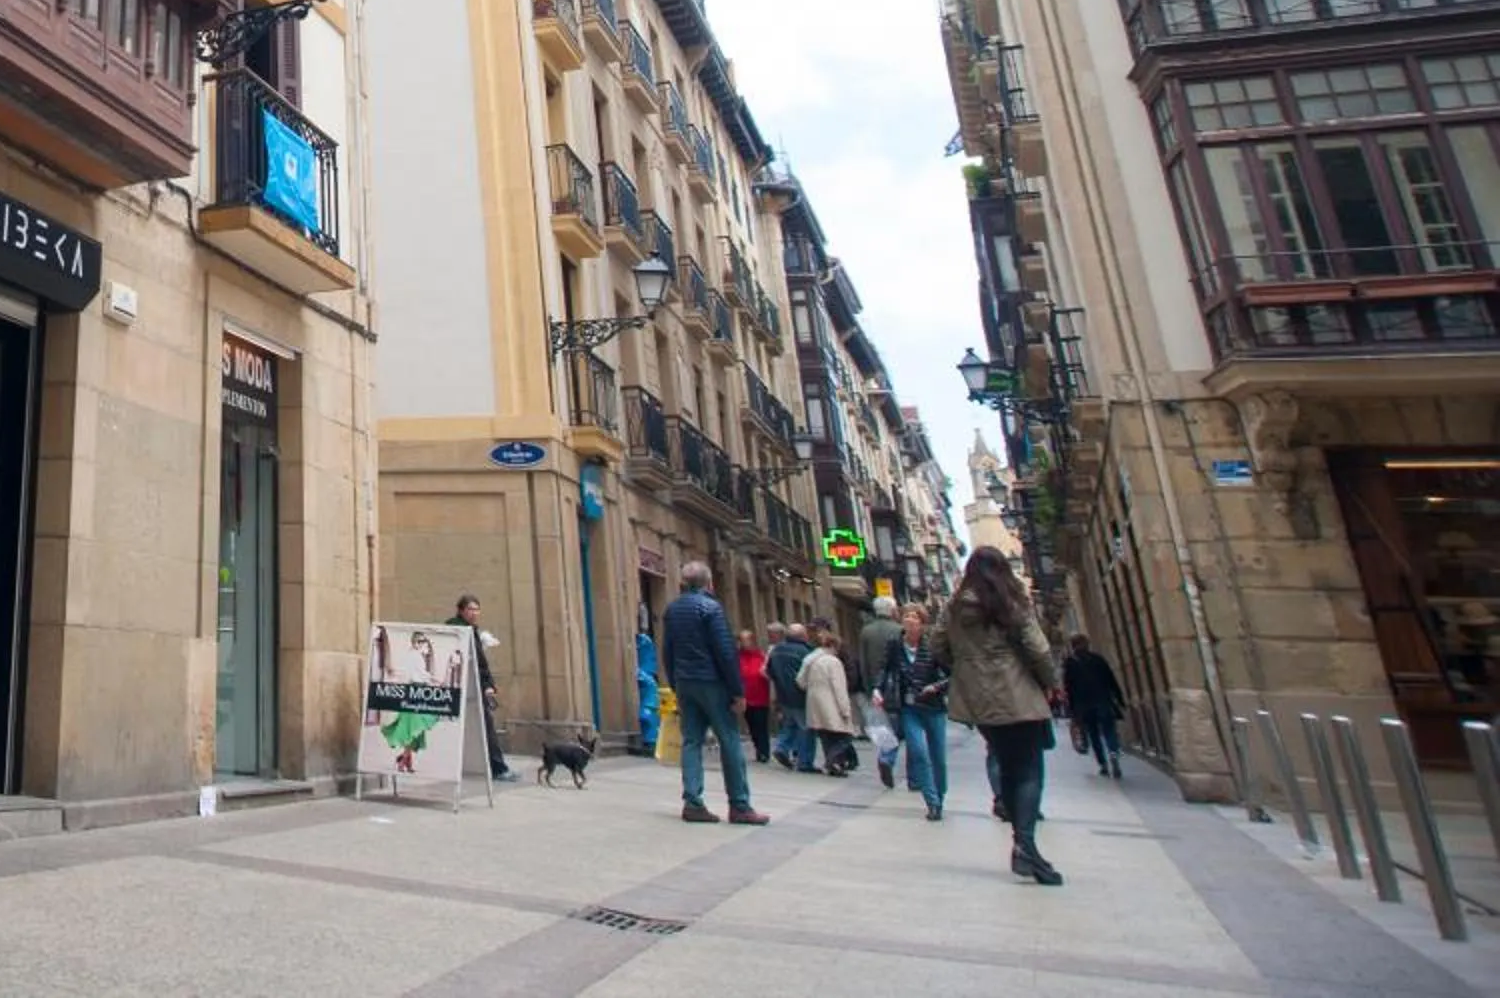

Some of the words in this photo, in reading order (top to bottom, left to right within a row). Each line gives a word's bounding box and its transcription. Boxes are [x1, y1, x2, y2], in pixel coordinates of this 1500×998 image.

[234, 346, 273, 393] MODA
[375, 683, 405, 699] MISS
[409, 686, 453, 702] MODA
